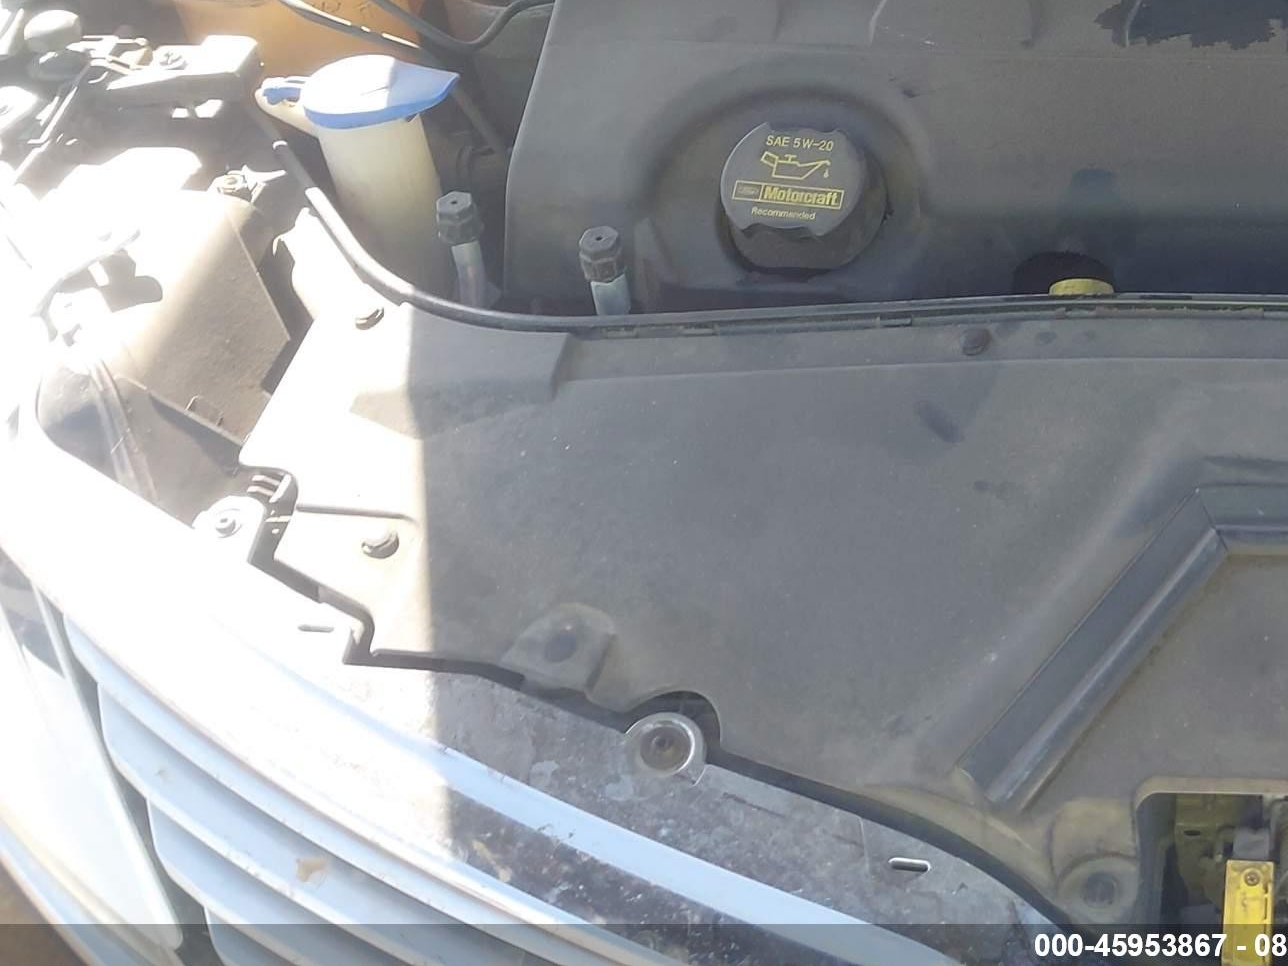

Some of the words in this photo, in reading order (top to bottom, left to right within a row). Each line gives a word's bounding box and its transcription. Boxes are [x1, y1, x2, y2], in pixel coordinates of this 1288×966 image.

[766, 135, 790, 147] SAE
[793, 137, 834, 152] 5W-20
[763, 185, 839, 206] Motorcraft
[751, 206, 816, 221] Recommended
